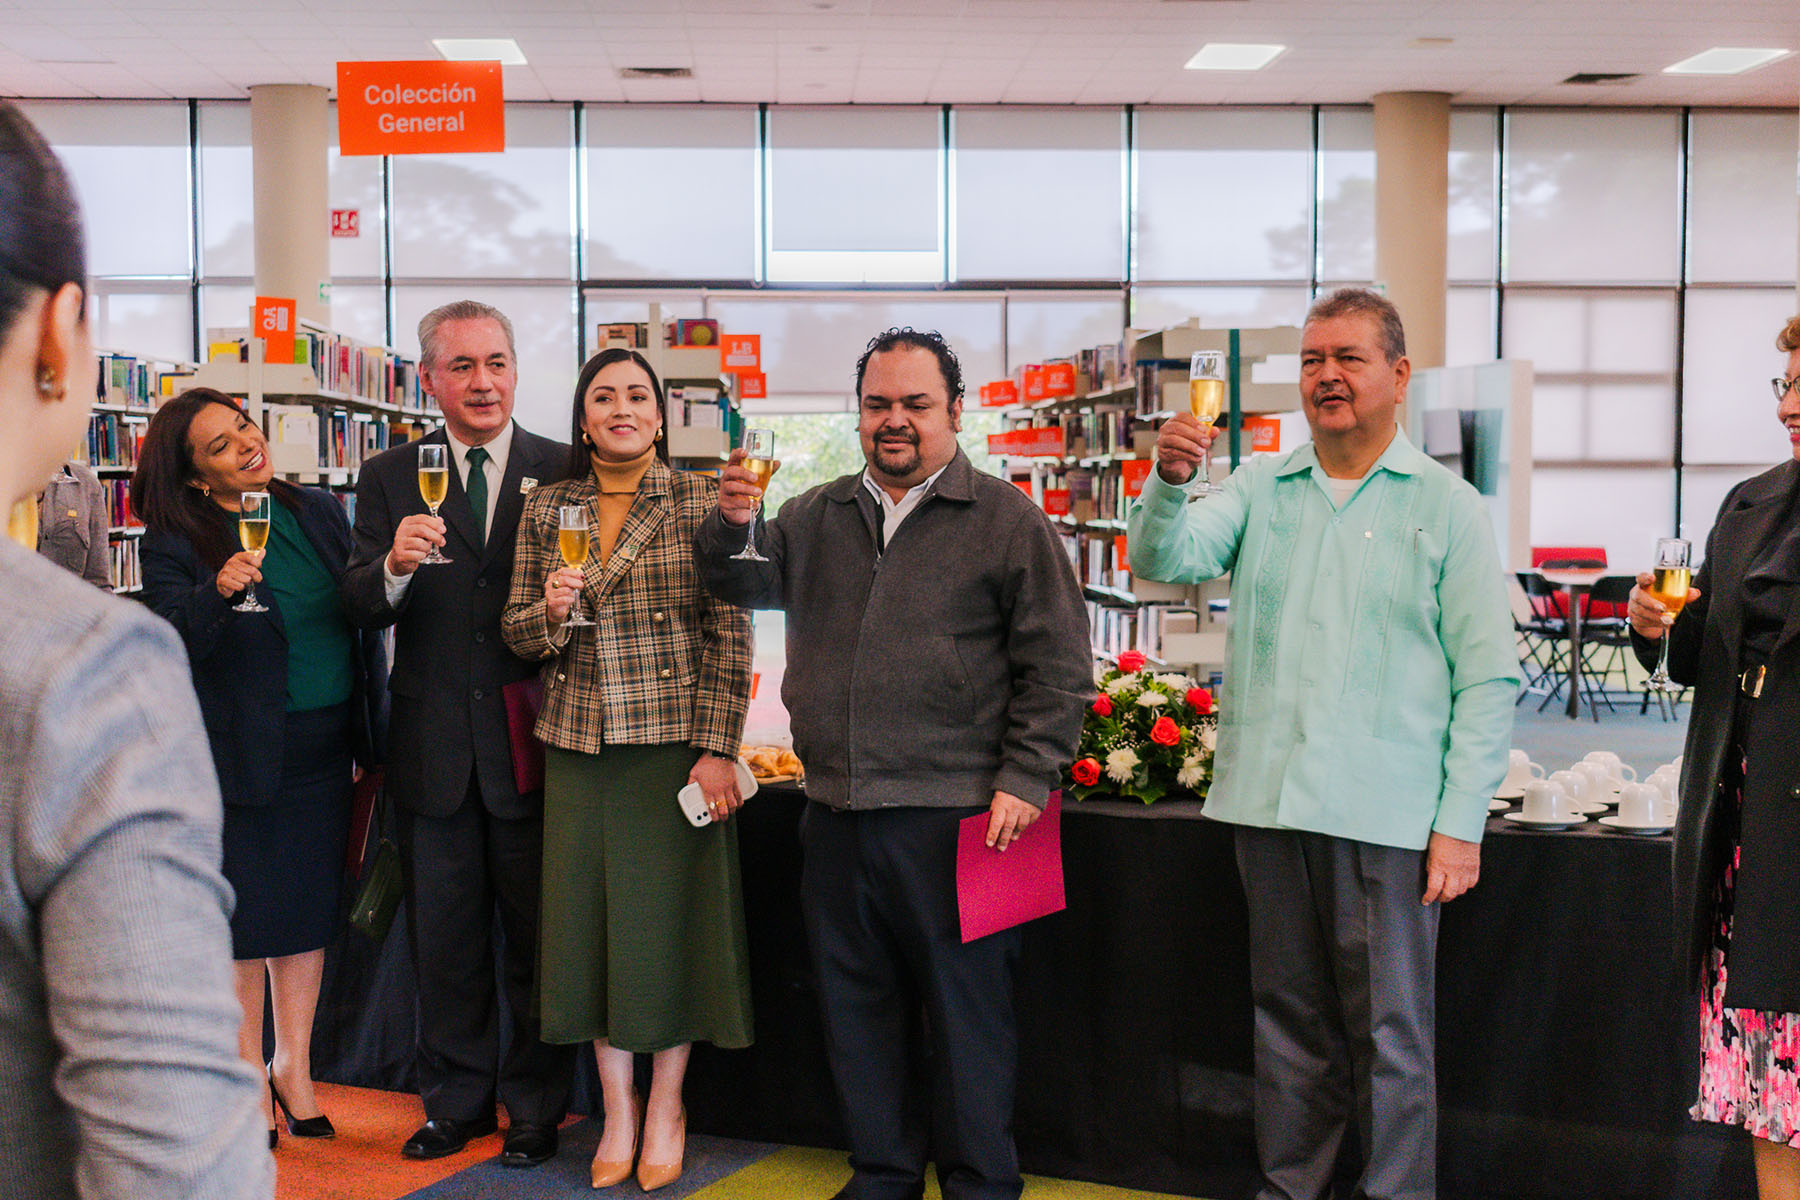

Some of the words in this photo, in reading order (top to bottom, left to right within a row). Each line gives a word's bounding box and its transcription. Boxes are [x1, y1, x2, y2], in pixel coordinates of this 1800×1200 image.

[364, 82, 476, 105] Colección
[378, 110, 465, 133] General
[263, 306, 277, 330] QA
[731, 341, 752, 354] LB
